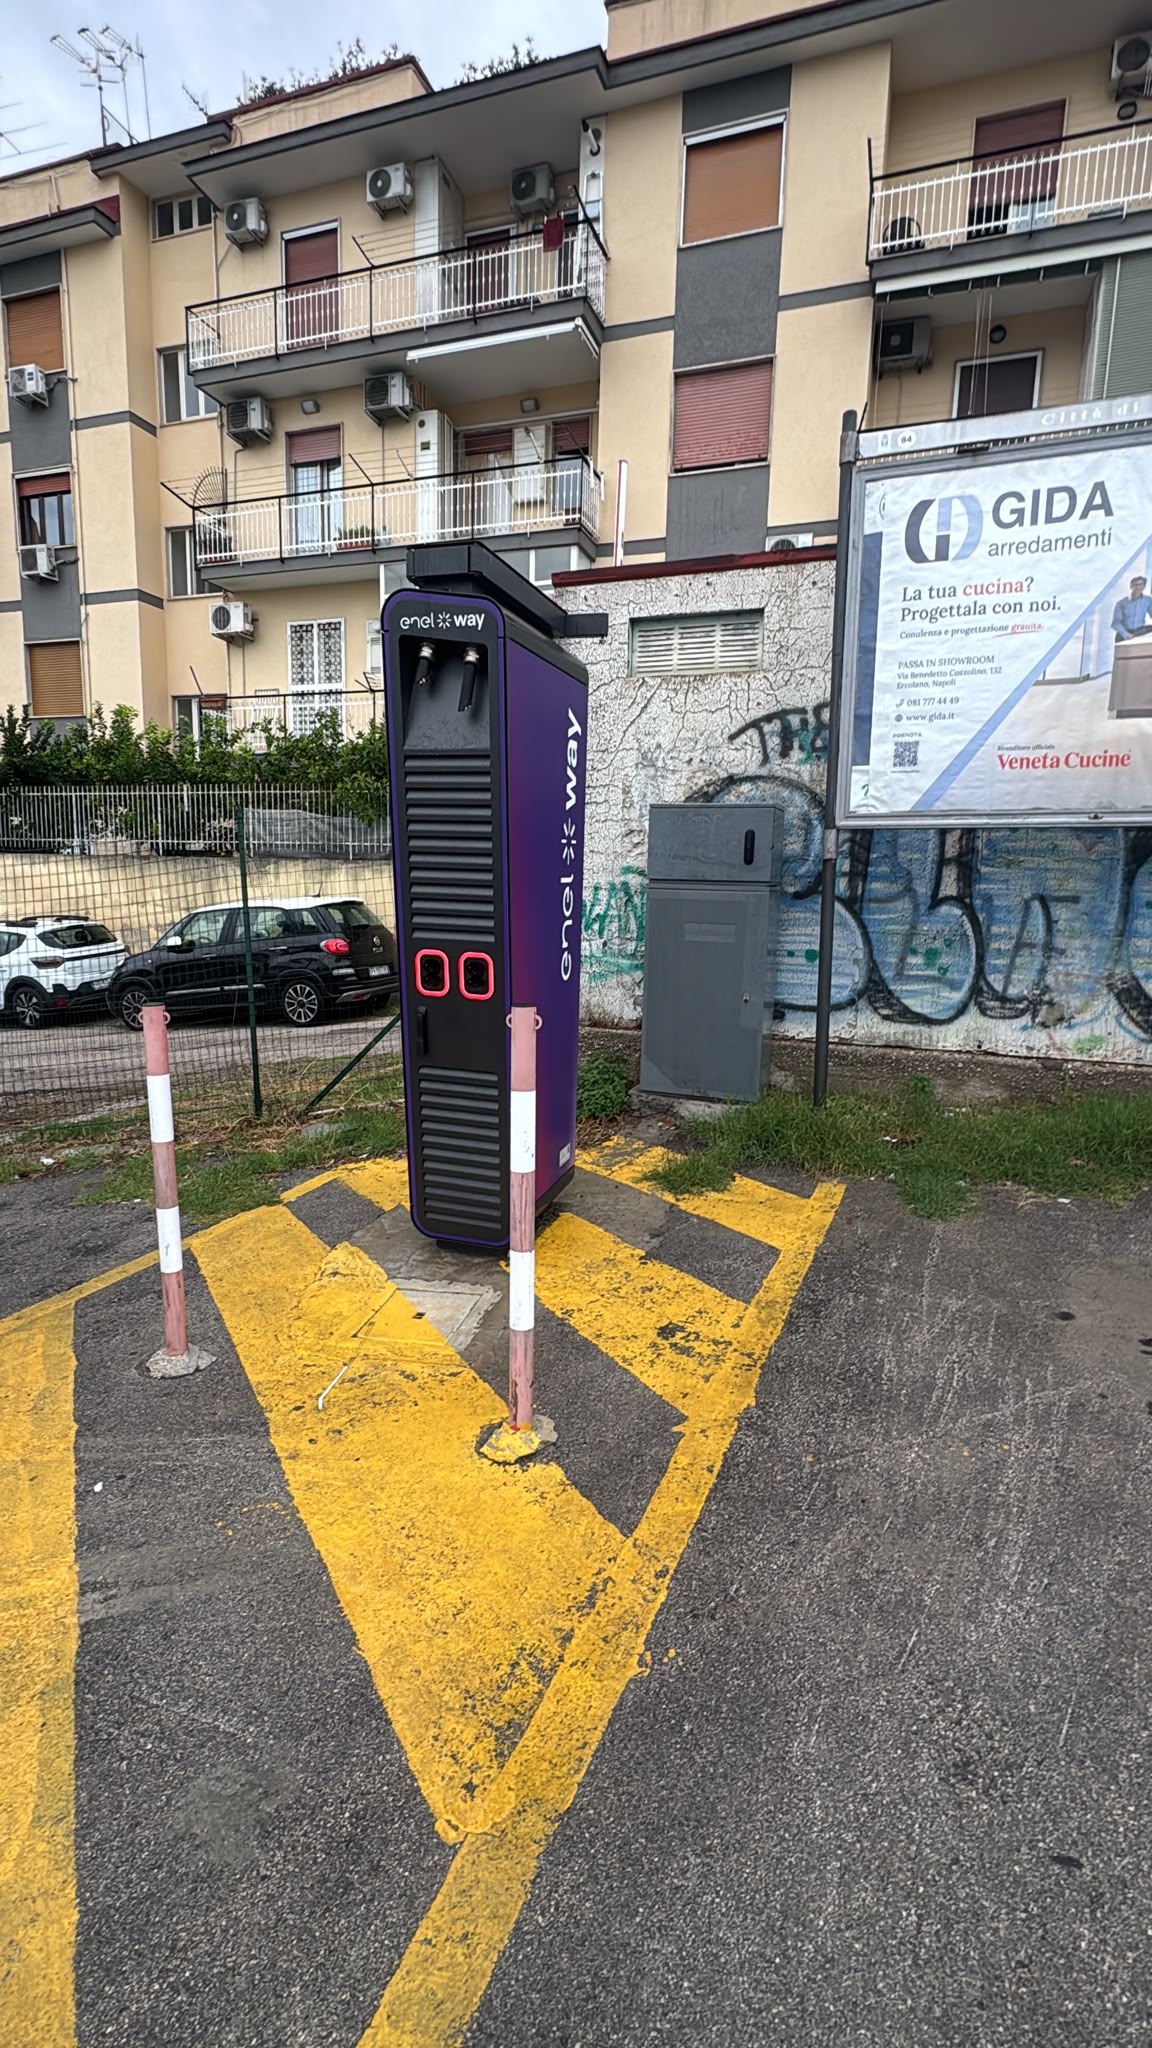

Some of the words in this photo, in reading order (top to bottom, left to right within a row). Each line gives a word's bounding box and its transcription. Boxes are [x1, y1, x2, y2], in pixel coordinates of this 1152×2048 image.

[991, 480, 1114, 529] GIDA
[988, 527, 1112, 557] arredamenti
[902, 586, 921, 602] La
[928, 583, 957, 600] tua
[962, 576, 1034, 597] cucina?
[900, 599, 987, 623] Progettala
[992, 600, 1024, 615] con
[1028, 595, 1061, 612] noi.
[400, 611, 435, 630] enel
[453, 612, 485, 631] way
[944, 629, 950, 637] e
[950, 624, 1009, 638] progettazione
[897, 672, 909, 680] Via
[910, 669, 948, 679] Benedetto
[949, 668, 988, 677] Cozzolino,
[990, 666, 1002, 674] 132
[898, 660, 924, 670] PASSA
[926, 658, 936, 667] IN
[938, 655, 995, 666] SHOWROOM
[896, 680, 931, 690] Ercolano,
[932, 679, 956, 689] Napoli
[906, 698, 921, 707] 081
[922, 697, 936, 706] 777
[937, 697, 947, 705] 44
[948, 696, 960, 704] 49
[905, 712, 955, 723] www.gida.it
[565, 708, 583, 811] way
[997, 752, 1061, 771] Veneta
[1063, 749, 1131, 769] Cucine
[560, 873, 575, 983] enel
